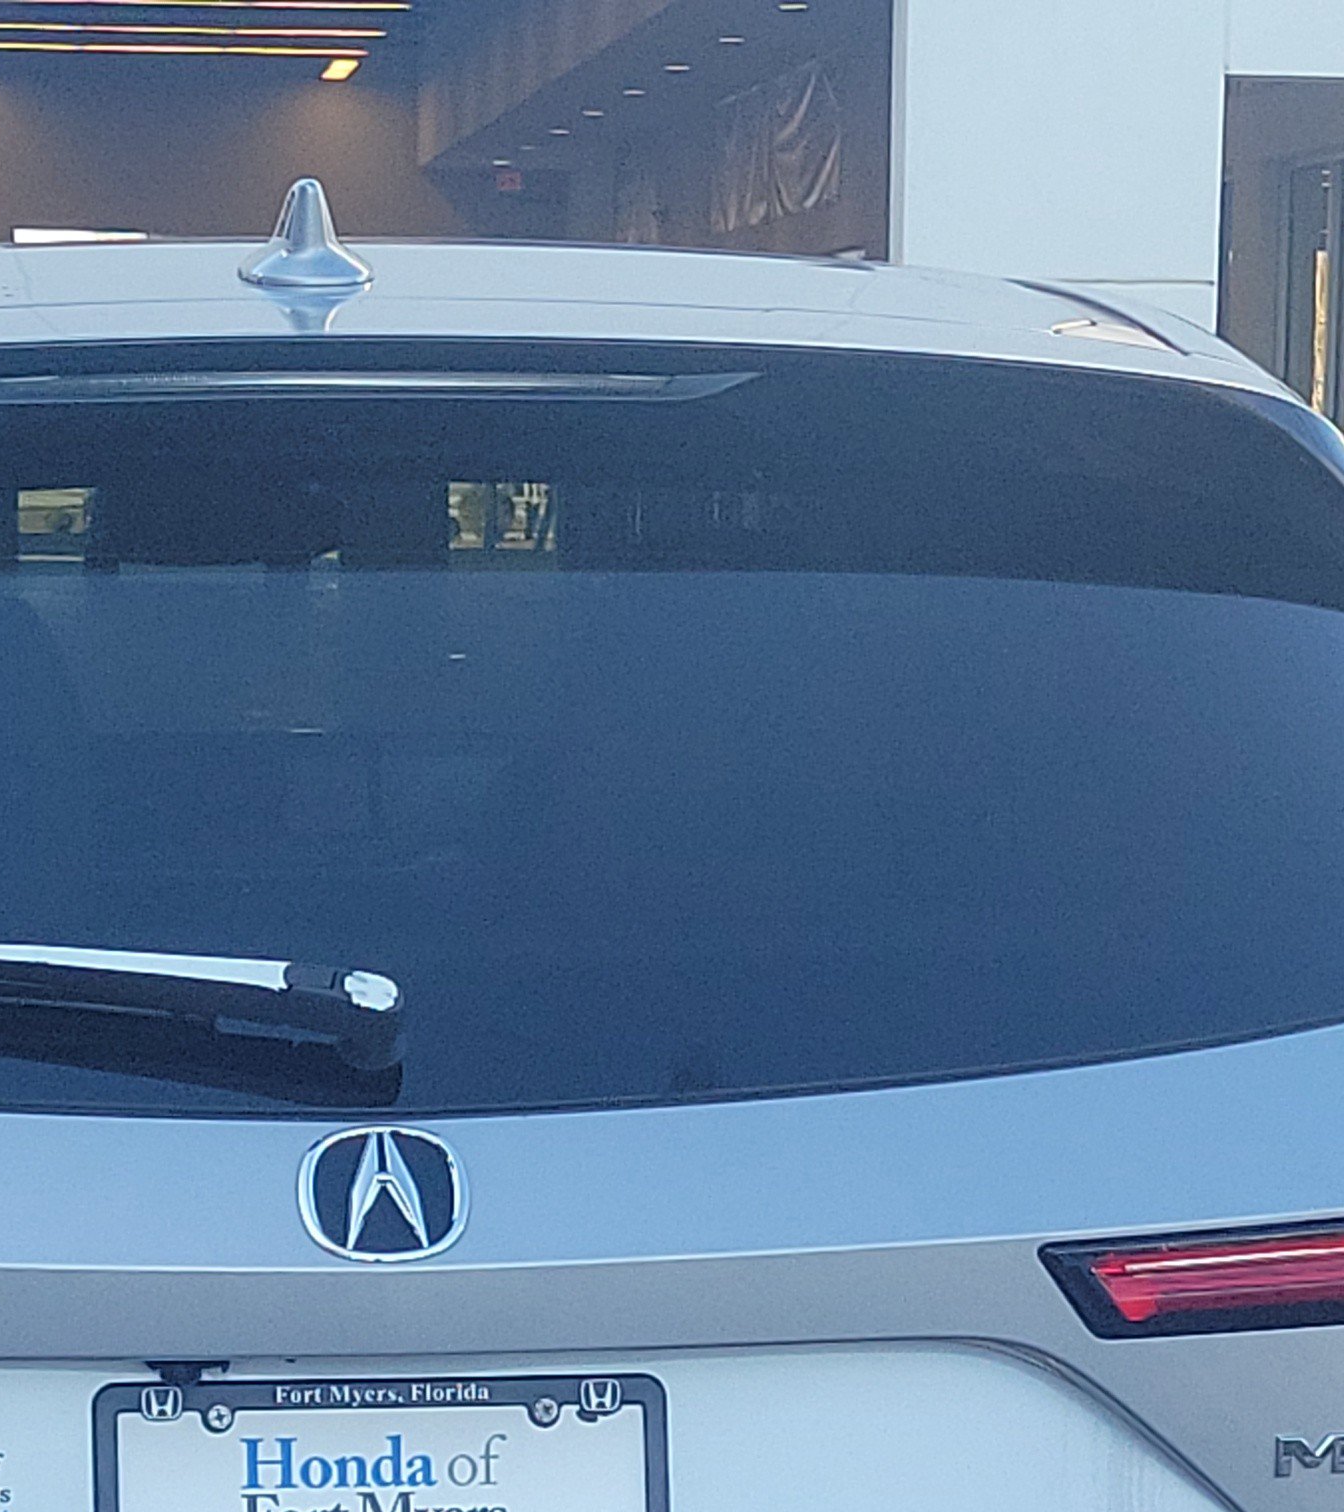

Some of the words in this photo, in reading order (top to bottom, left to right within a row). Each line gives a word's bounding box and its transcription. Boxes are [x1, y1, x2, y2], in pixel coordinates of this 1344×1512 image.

[275, 1385, 322, 1403] Fort
[411, 1382, 490, 1401] Florida
[240, 1434, 438, 1489] Honda
[447, 1434, 508, 1487] of
